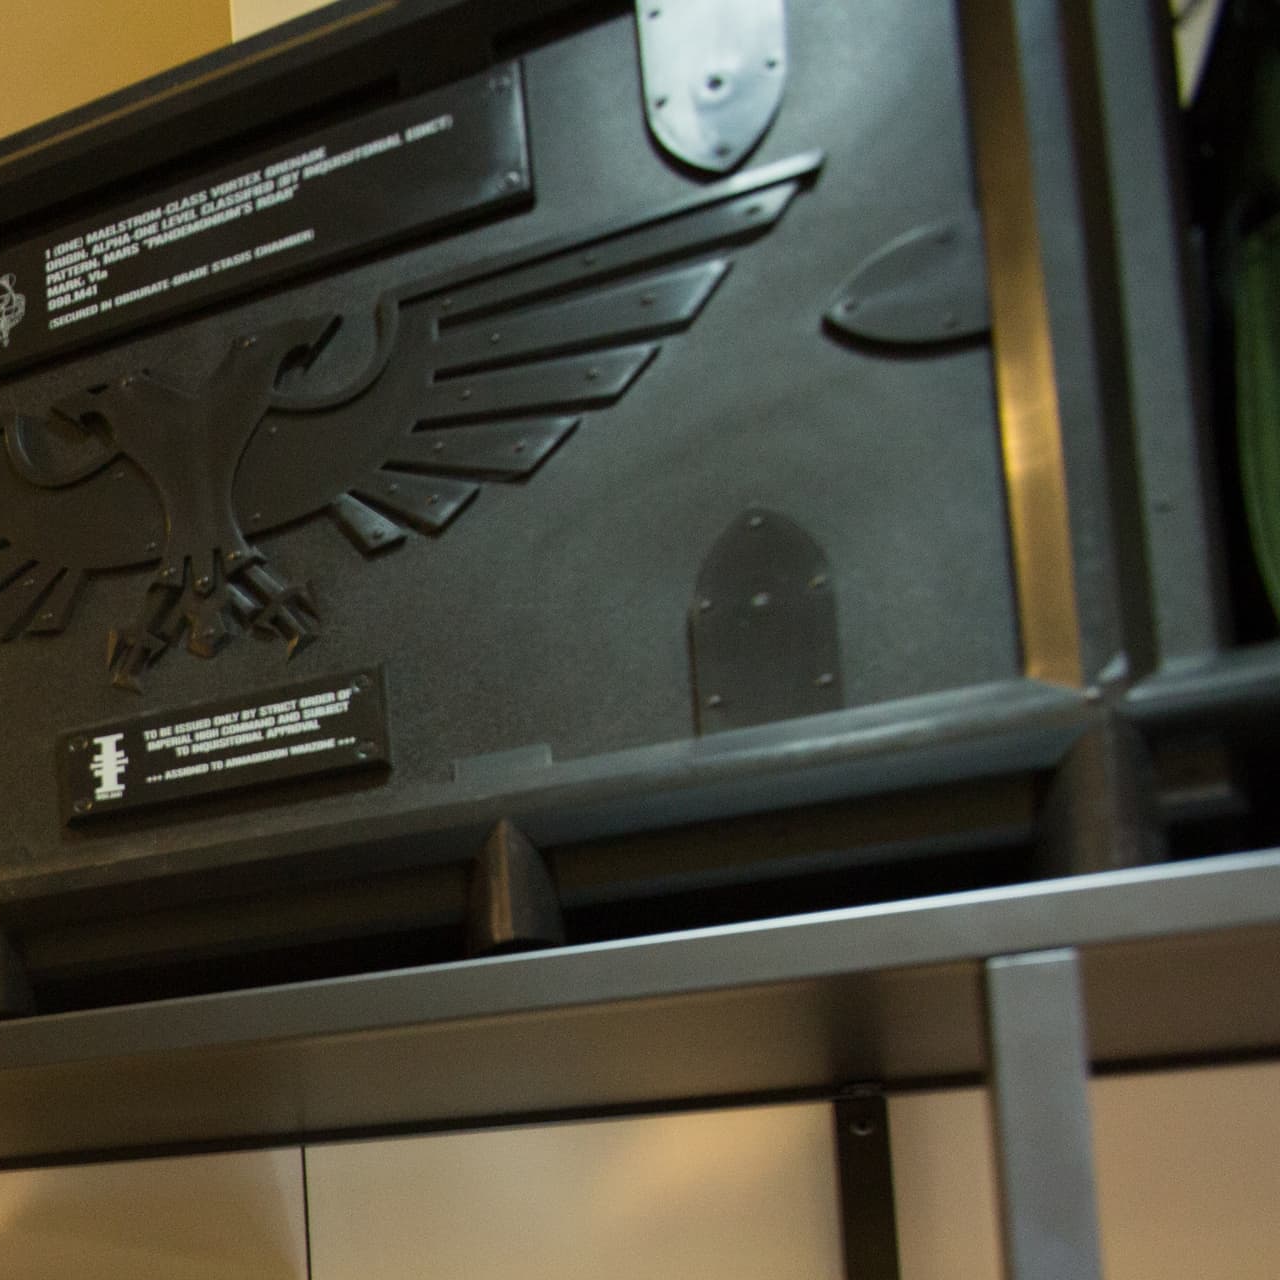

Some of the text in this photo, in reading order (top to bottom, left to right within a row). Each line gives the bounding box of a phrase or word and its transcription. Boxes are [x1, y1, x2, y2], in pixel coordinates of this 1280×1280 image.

[53, 236, 84, 257] (ONE)
[209, 170, 261, 199] VORTEX
[160, 208, 198, 230] LEVEL
[199, 179, 275, 216] CLASSIFIED
[102, 243, 140, 265] MARS
[210, 250, 253, 274] STASIS
[143, 728, 158, 741] TO
[159, 726, 173, 738] BE
[173, 717, 212, 735] ISSUED
[212, 711, 240, 727] ONLY
[240, 707, 257, 721] BY
[258, 699, 298, 718] STRICT
[146, 733, 193, 752] IMPERIAL
[220, 715, 276, 737] COMMAND
[175, 744, 190, 758] TO
